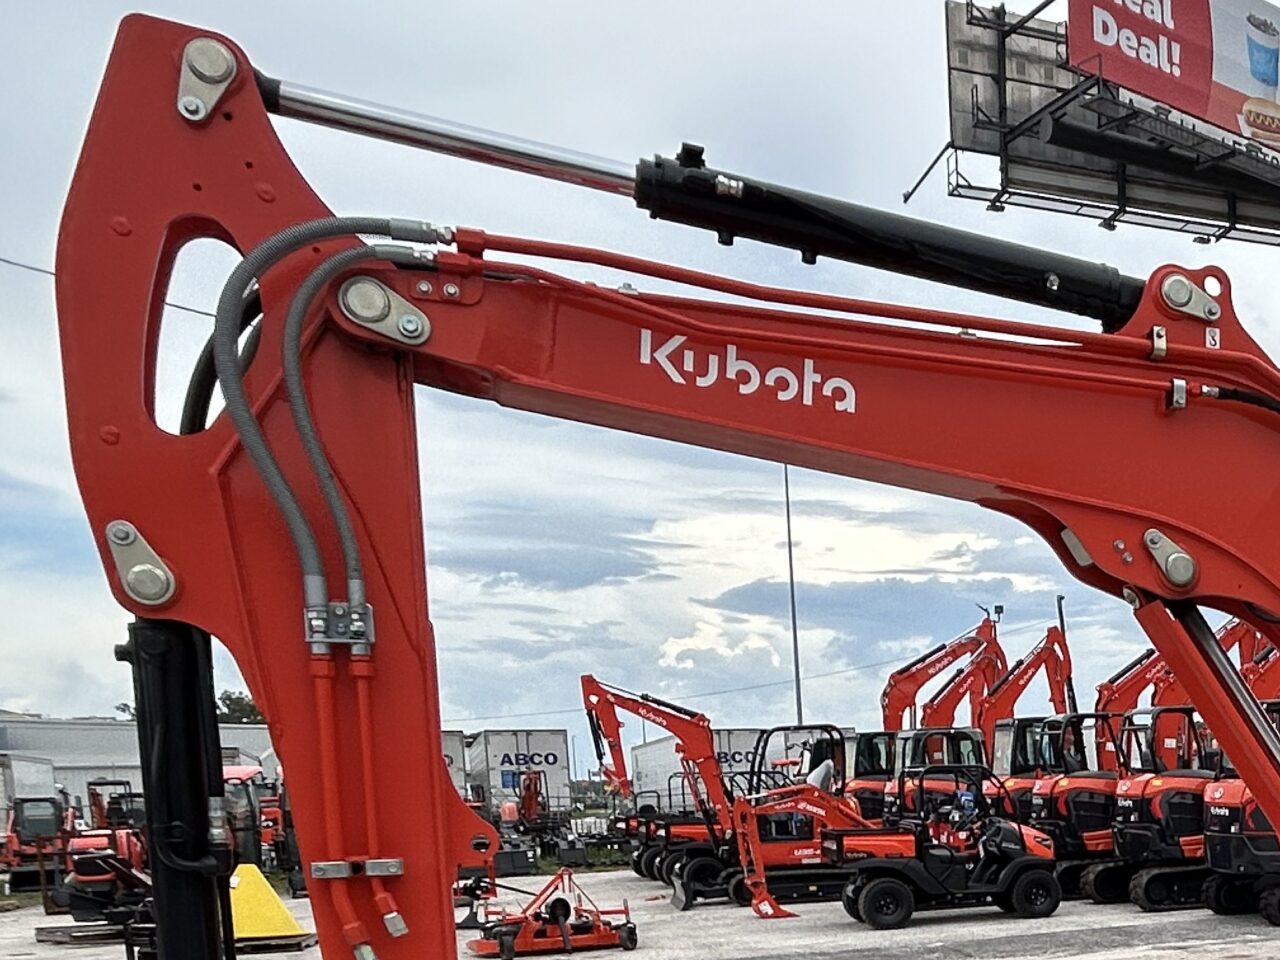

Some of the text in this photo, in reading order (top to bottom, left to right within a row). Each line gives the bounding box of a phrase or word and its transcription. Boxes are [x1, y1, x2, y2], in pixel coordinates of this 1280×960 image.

[1113, 0, 1175, 30] eal
[1092, 5, 1181, 77] Deal!
[639, 328, 856, 413] Kubota
[500, 752, 558, 766] ABCO
[717, 751, 755, 764] BCO
